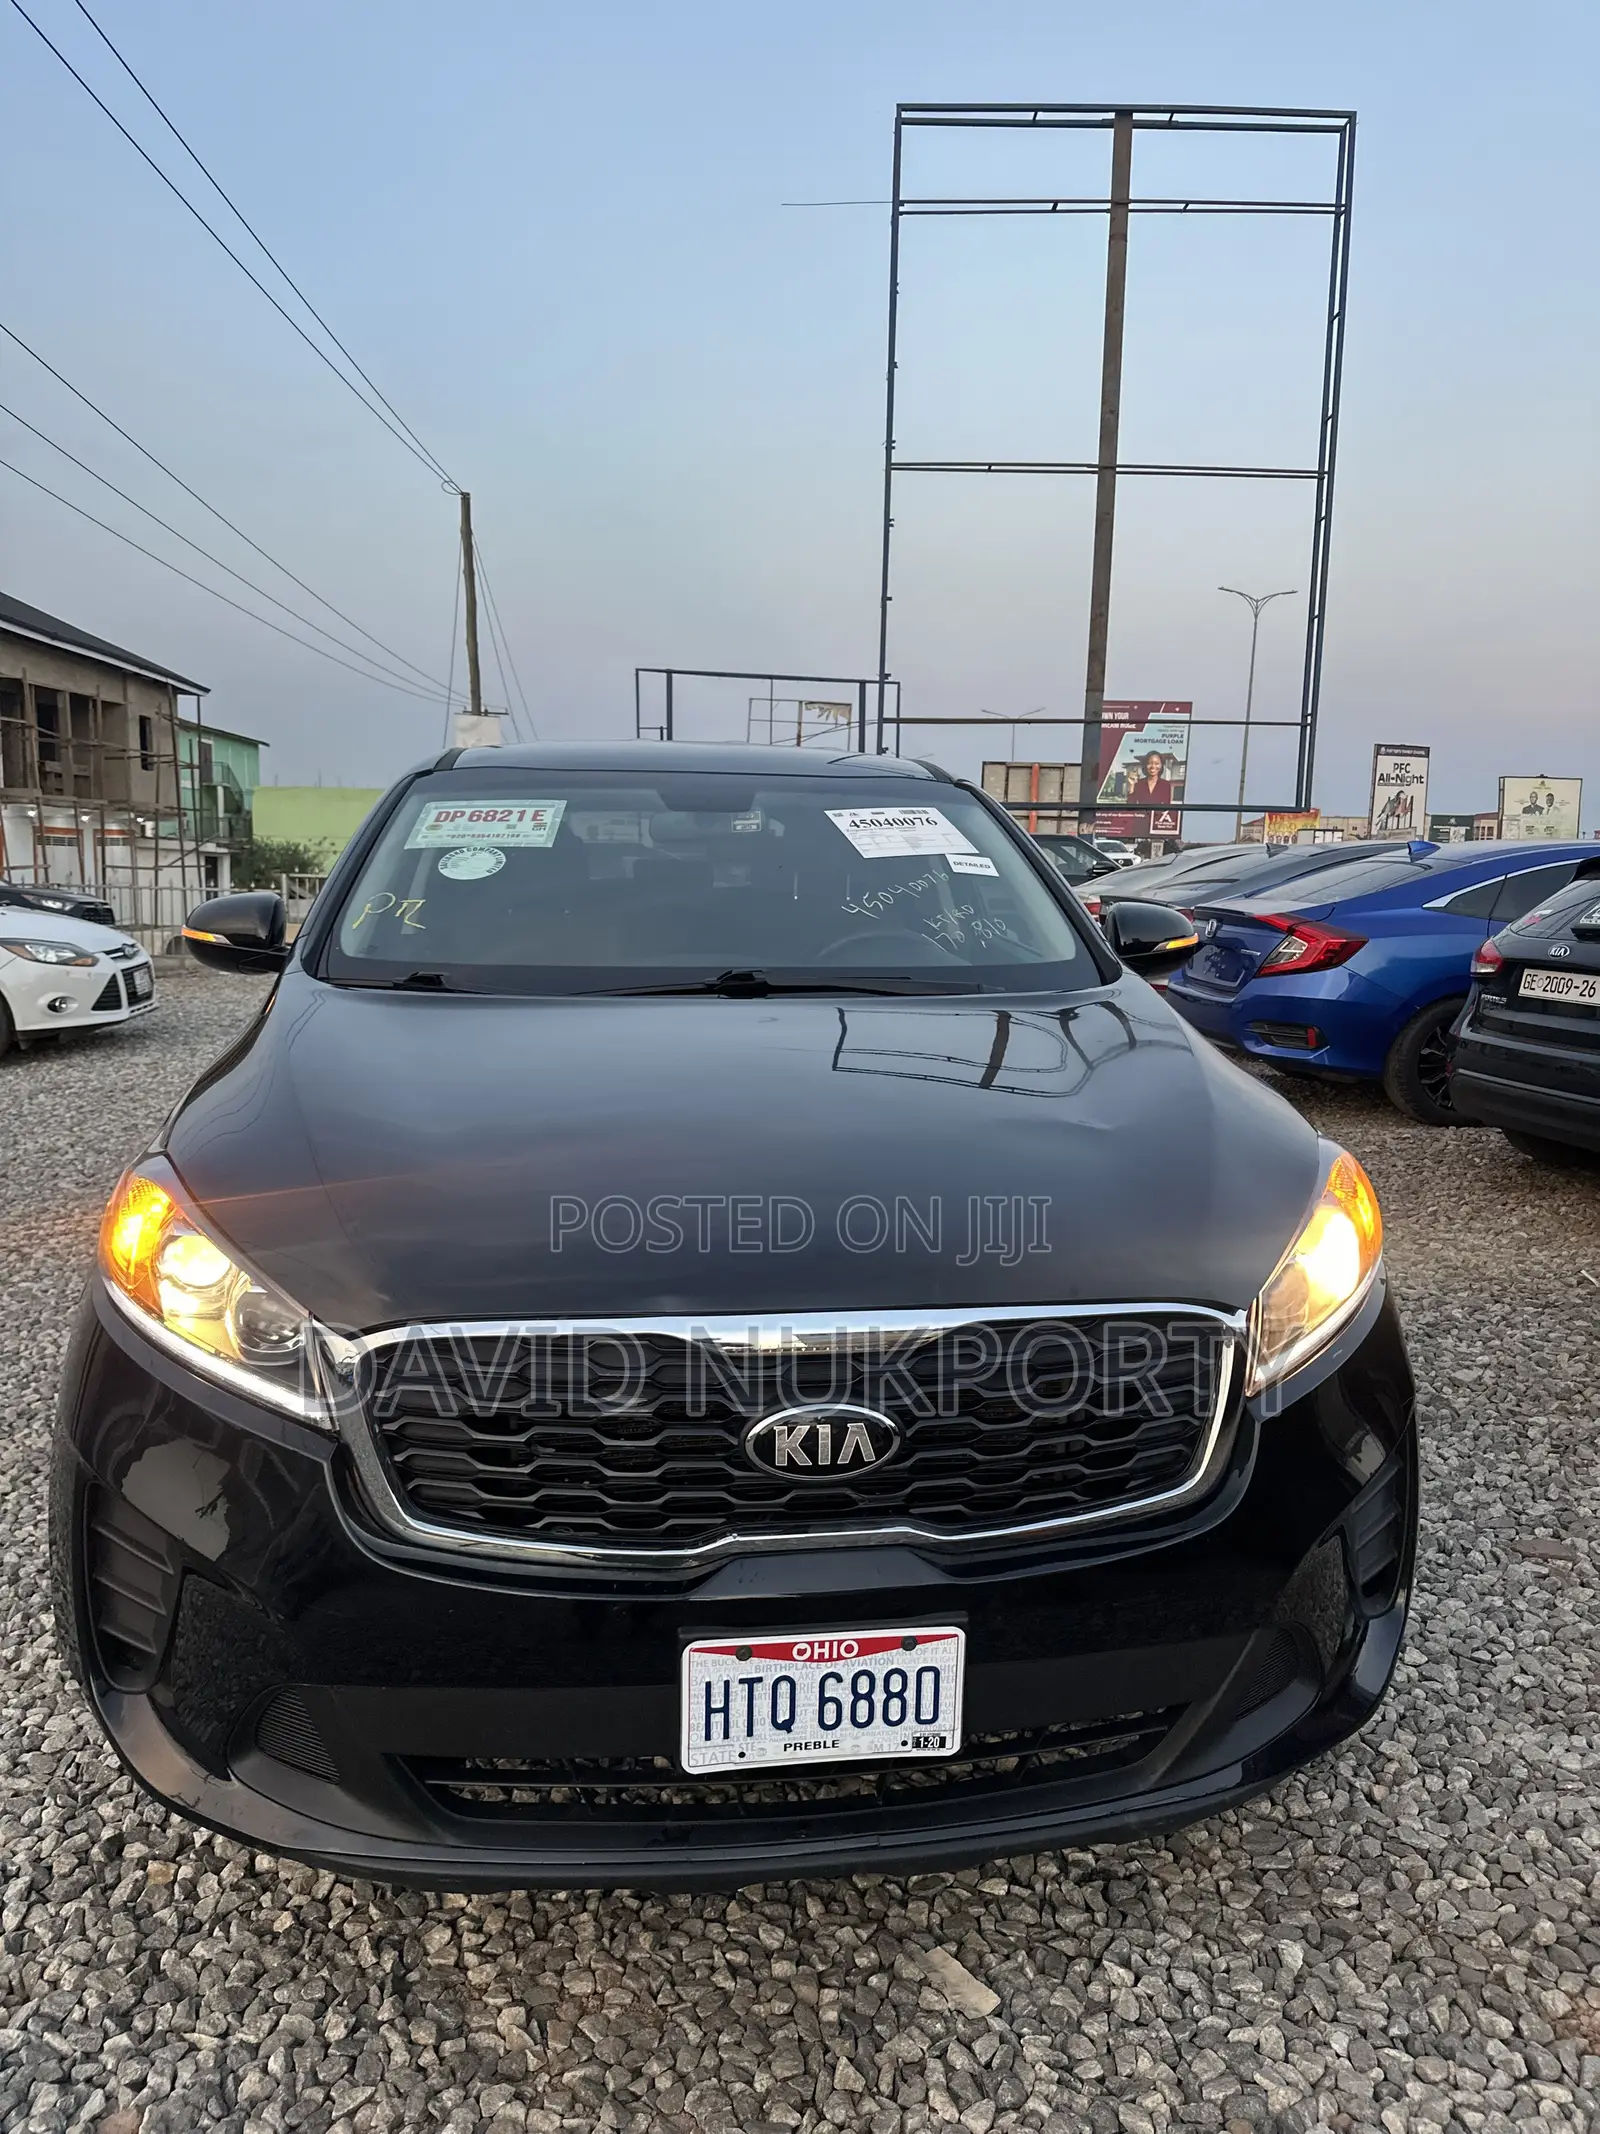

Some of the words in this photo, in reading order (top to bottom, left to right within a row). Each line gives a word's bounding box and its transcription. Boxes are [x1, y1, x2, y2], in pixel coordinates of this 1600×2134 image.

[1393, 763, 1411, 774] PFC
[1378, 773, 1425, 787] All-Night
[434, 810, 466, 823] DP
[468, 809, 527, 823] 6821
[531, 809, 547, 822] E
[849, 816, 938, 829] 45040076
[952, 860, 991, 869] DETAILED
[841, 869, 950, 920] 45040076
[1550, 946, 1566, 957] KIA
[1523, 973, 1538, 991] GE
[1543, 975, 1597, 998] 2009-26
[773, 1422, 876, 1467] KIA
[792, 1639, 860, 1661] OHIO
[755, 1662, 822, 1674] BIRTHPLACE
[842, 1657, 894, 1668] AVIATION
[704, 1675, 796, 1741] HTQ
[818, 1666, 940, 1731] 6880
[784, 1739, 840, 1752] PREBLE
[918, 1735, 941, 1749] 1-20
